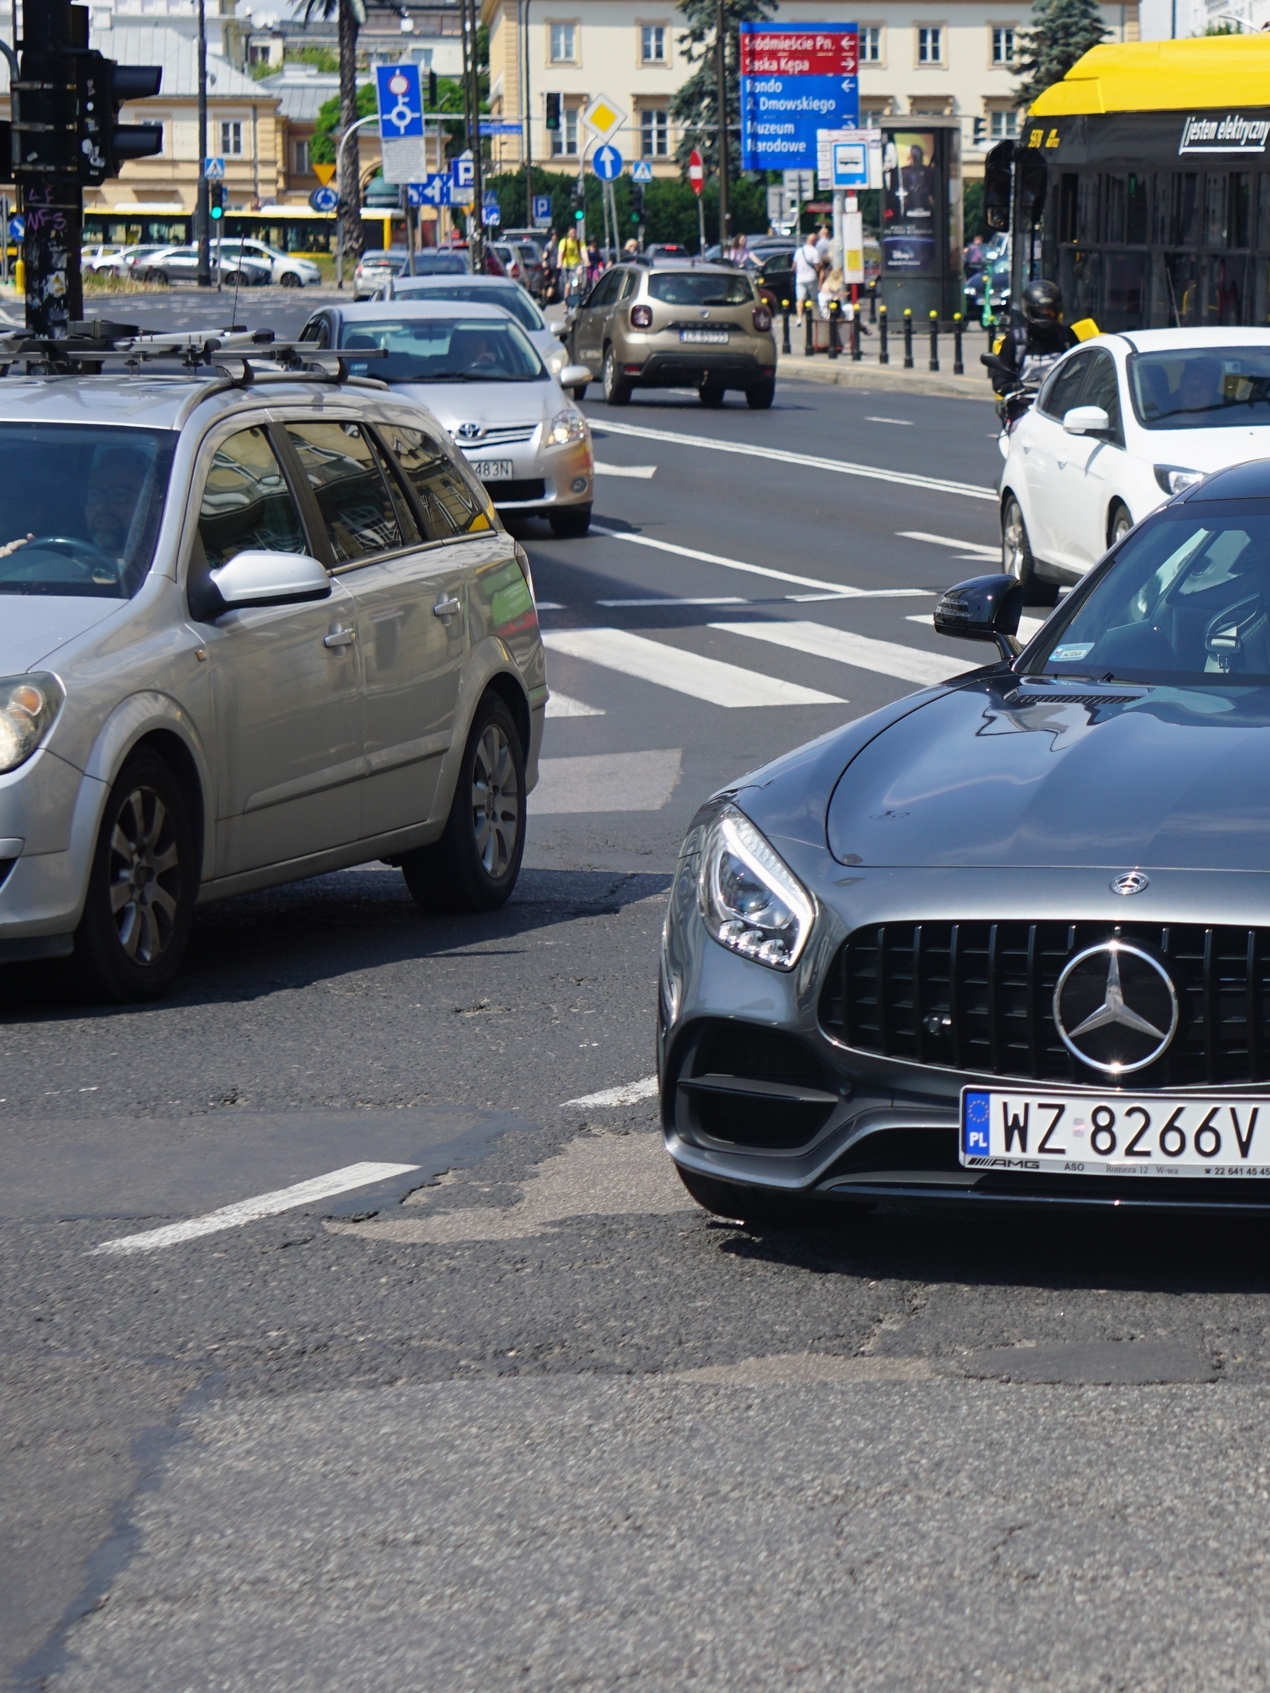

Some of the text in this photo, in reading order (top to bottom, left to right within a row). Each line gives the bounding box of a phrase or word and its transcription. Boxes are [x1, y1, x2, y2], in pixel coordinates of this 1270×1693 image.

[815, 36, 836, 51] Pn.
[745, 57, 809, 74] Saska Kępa
[746, 78, 783, 93] Rondo
[759, 95, 836, 114] Dmowskiego
[746, 120, 795, 135] Muzeum
[1184, 116, 1219, 147] jestem
[747, 138, 807, 153] Narodowe
[537, 199, 548, 216] P
[1001, 1100, 1260, 1159] WZ 8266V
[969, 1131, 988, 1148] PL
[992, 1158, 1041, 1170] AMG
[1063, 1163, 1085, 1173] ASO
[1105, 1165, 1137, 1175] Romera
[1139, 1165, 1149, 1175] 12
[1156, 1166, 1179, 1175] W-wa
[1214, 1168, 1226, 1176] 22
[1246, 1168, 1258, 1177] 45
